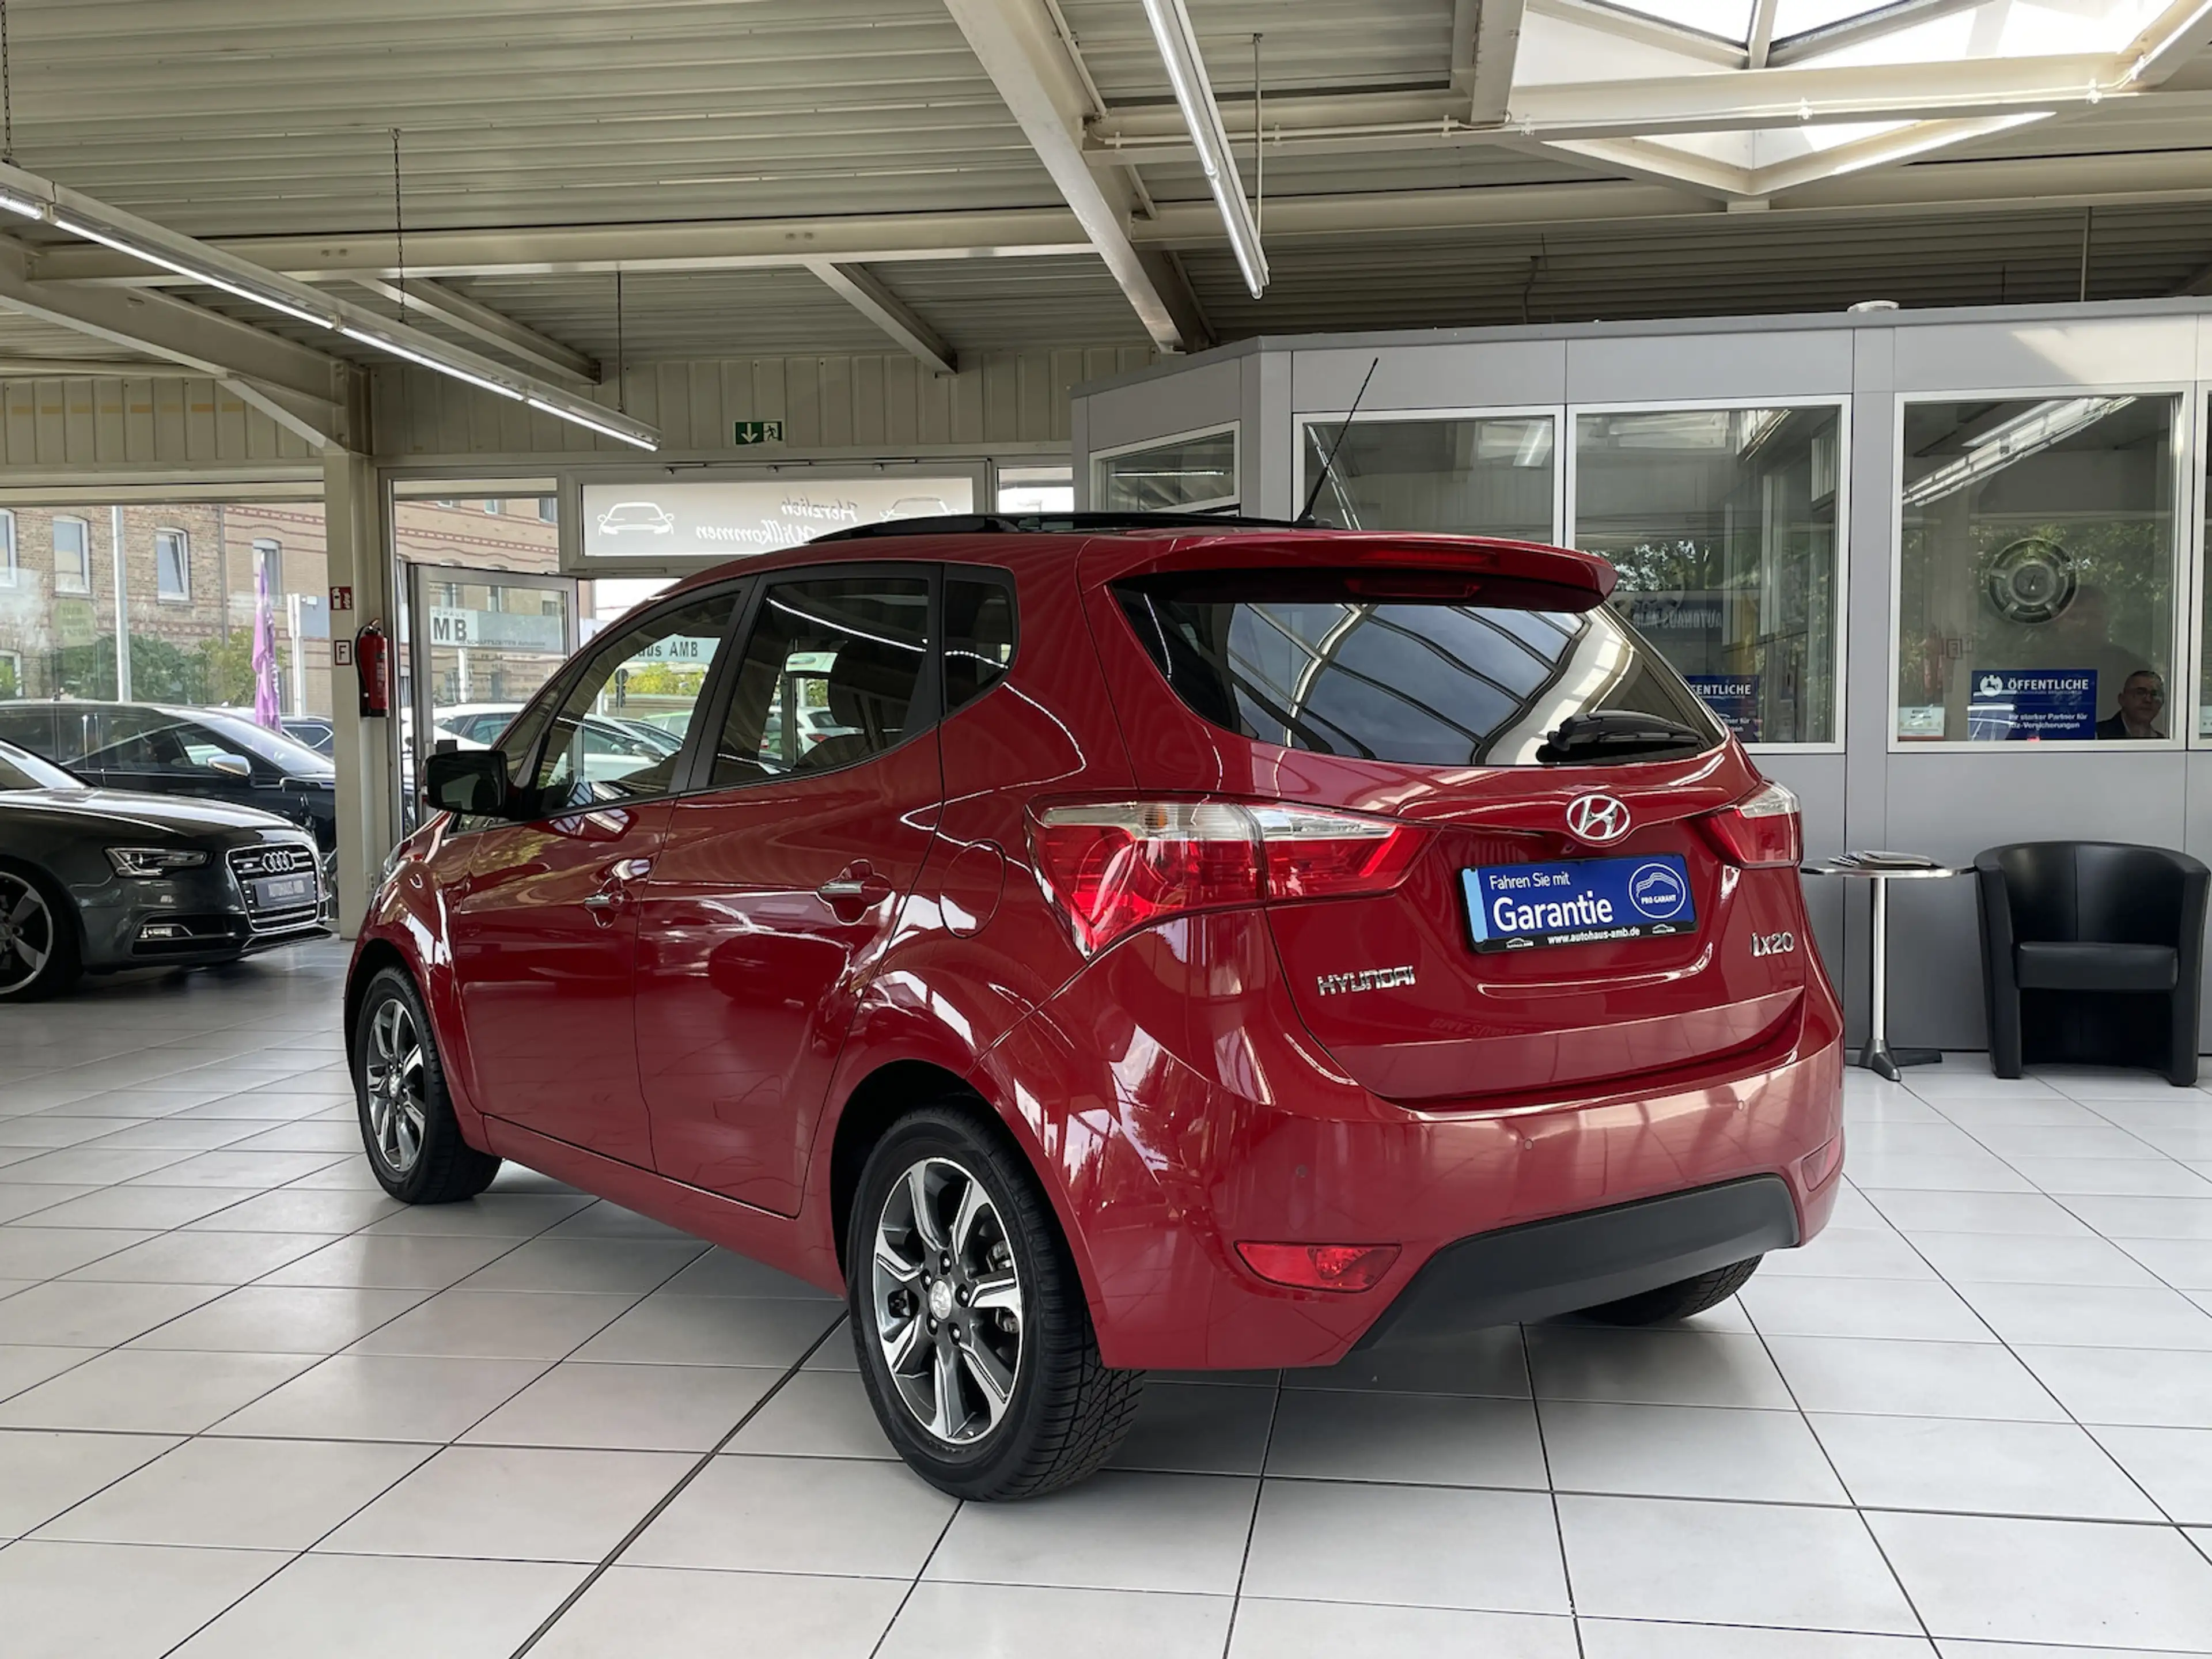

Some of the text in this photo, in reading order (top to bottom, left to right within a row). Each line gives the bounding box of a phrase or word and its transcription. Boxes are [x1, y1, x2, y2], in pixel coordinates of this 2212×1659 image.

[339, 645, 347, 660] F
[669, 641, 698, 657] AMB
[2008, 678, 2089, 690] ÖFFENTLICHE
[1489, 870, 1571, 890] Fahren Sie mit
[1493, 890, 1613, 931] Garantie
[1547, 926, 1641, 945] www.autohaus-amb.de
[1317, 965, 1416, 996] HYUNDAI
